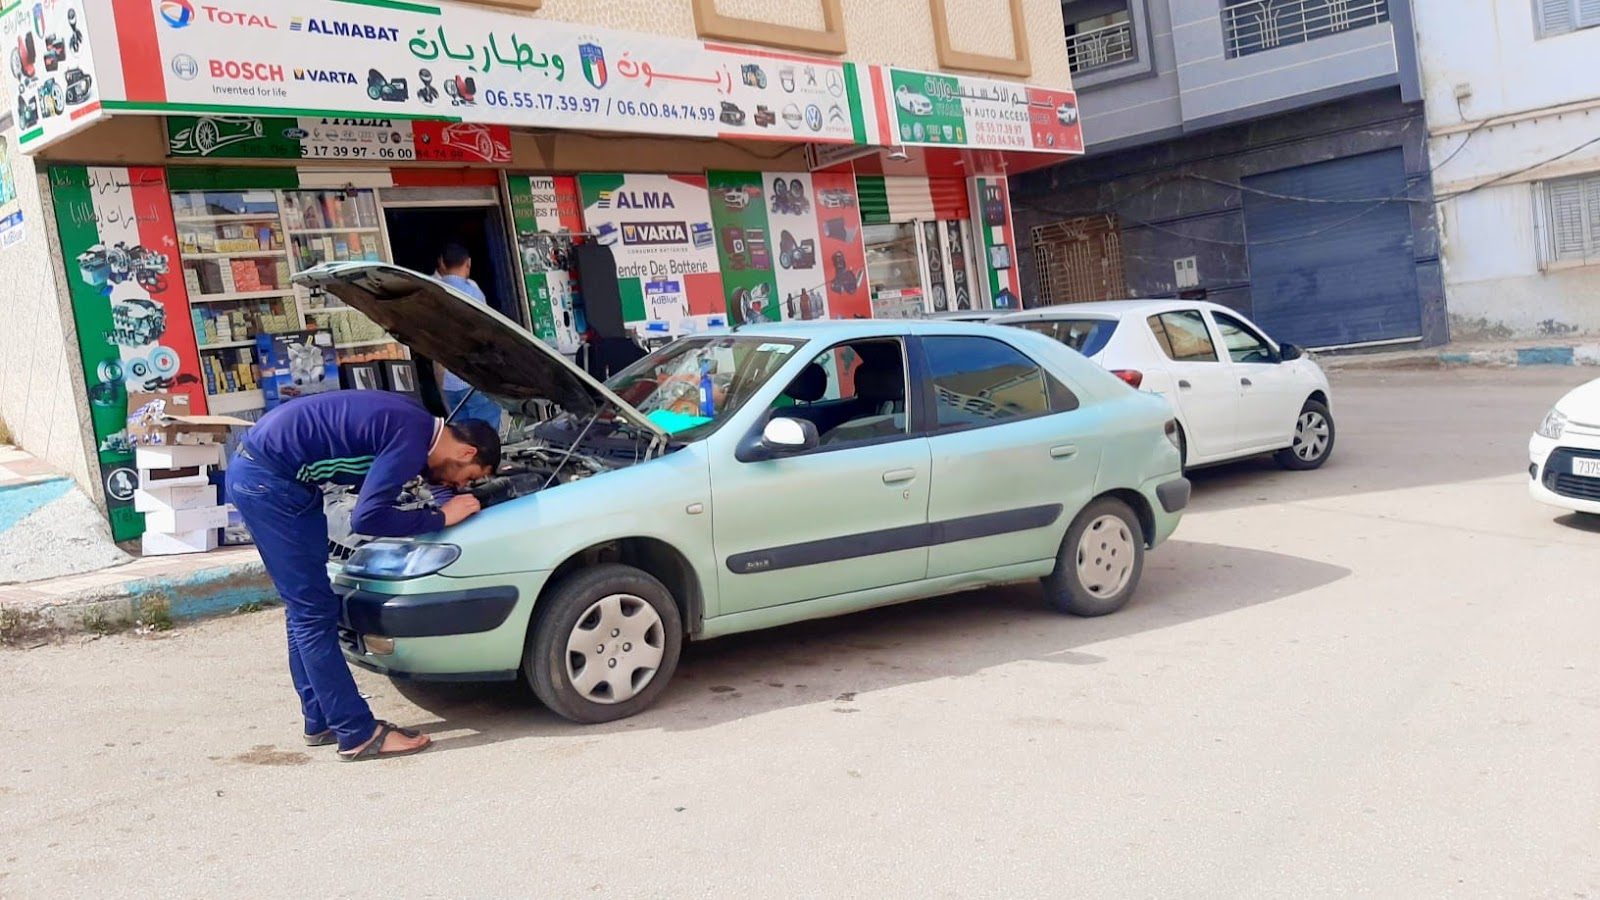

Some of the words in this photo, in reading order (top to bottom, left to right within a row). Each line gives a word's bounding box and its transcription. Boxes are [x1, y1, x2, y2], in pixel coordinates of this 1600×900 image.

[202, 5, 278, 29] TOTAL
[308, 18, 399, 42] ALMABAT
[408, 26, 565, 82] وبطاريات
[209, 60, 284, 82] BOSCH
[307, 69, 358, 84] VARTA
[616, 51, 731, 95] زيوت
[212, 84, 255, 96] Invented
[257, 86, 270, 97] for
[272, 87, 287, 98] life
[485, 88, 600, 113] 06.55.17.39.97
[617, 100, 715, 121] 06.00.84.74.99
[975, 108, 997, 119] AUTO
[314, 146, 328, 156] 17
[333, 146, 348, 157] 39
[352, 147, 367, 157] 97
[379, 147, 394, 158] 06
[398, 148, 412, 158] 00
[531, 180, 555, 189] AUTO
[617, 191, 675, 209] ALMA
[636, 224, 686, 241] VARTA
[618, 261, 648, 278] endre
[649, 260, 668, 276] Des
[669, 258, 708, 275] Batterie
[651, 295, 678, 305] AdBlue
